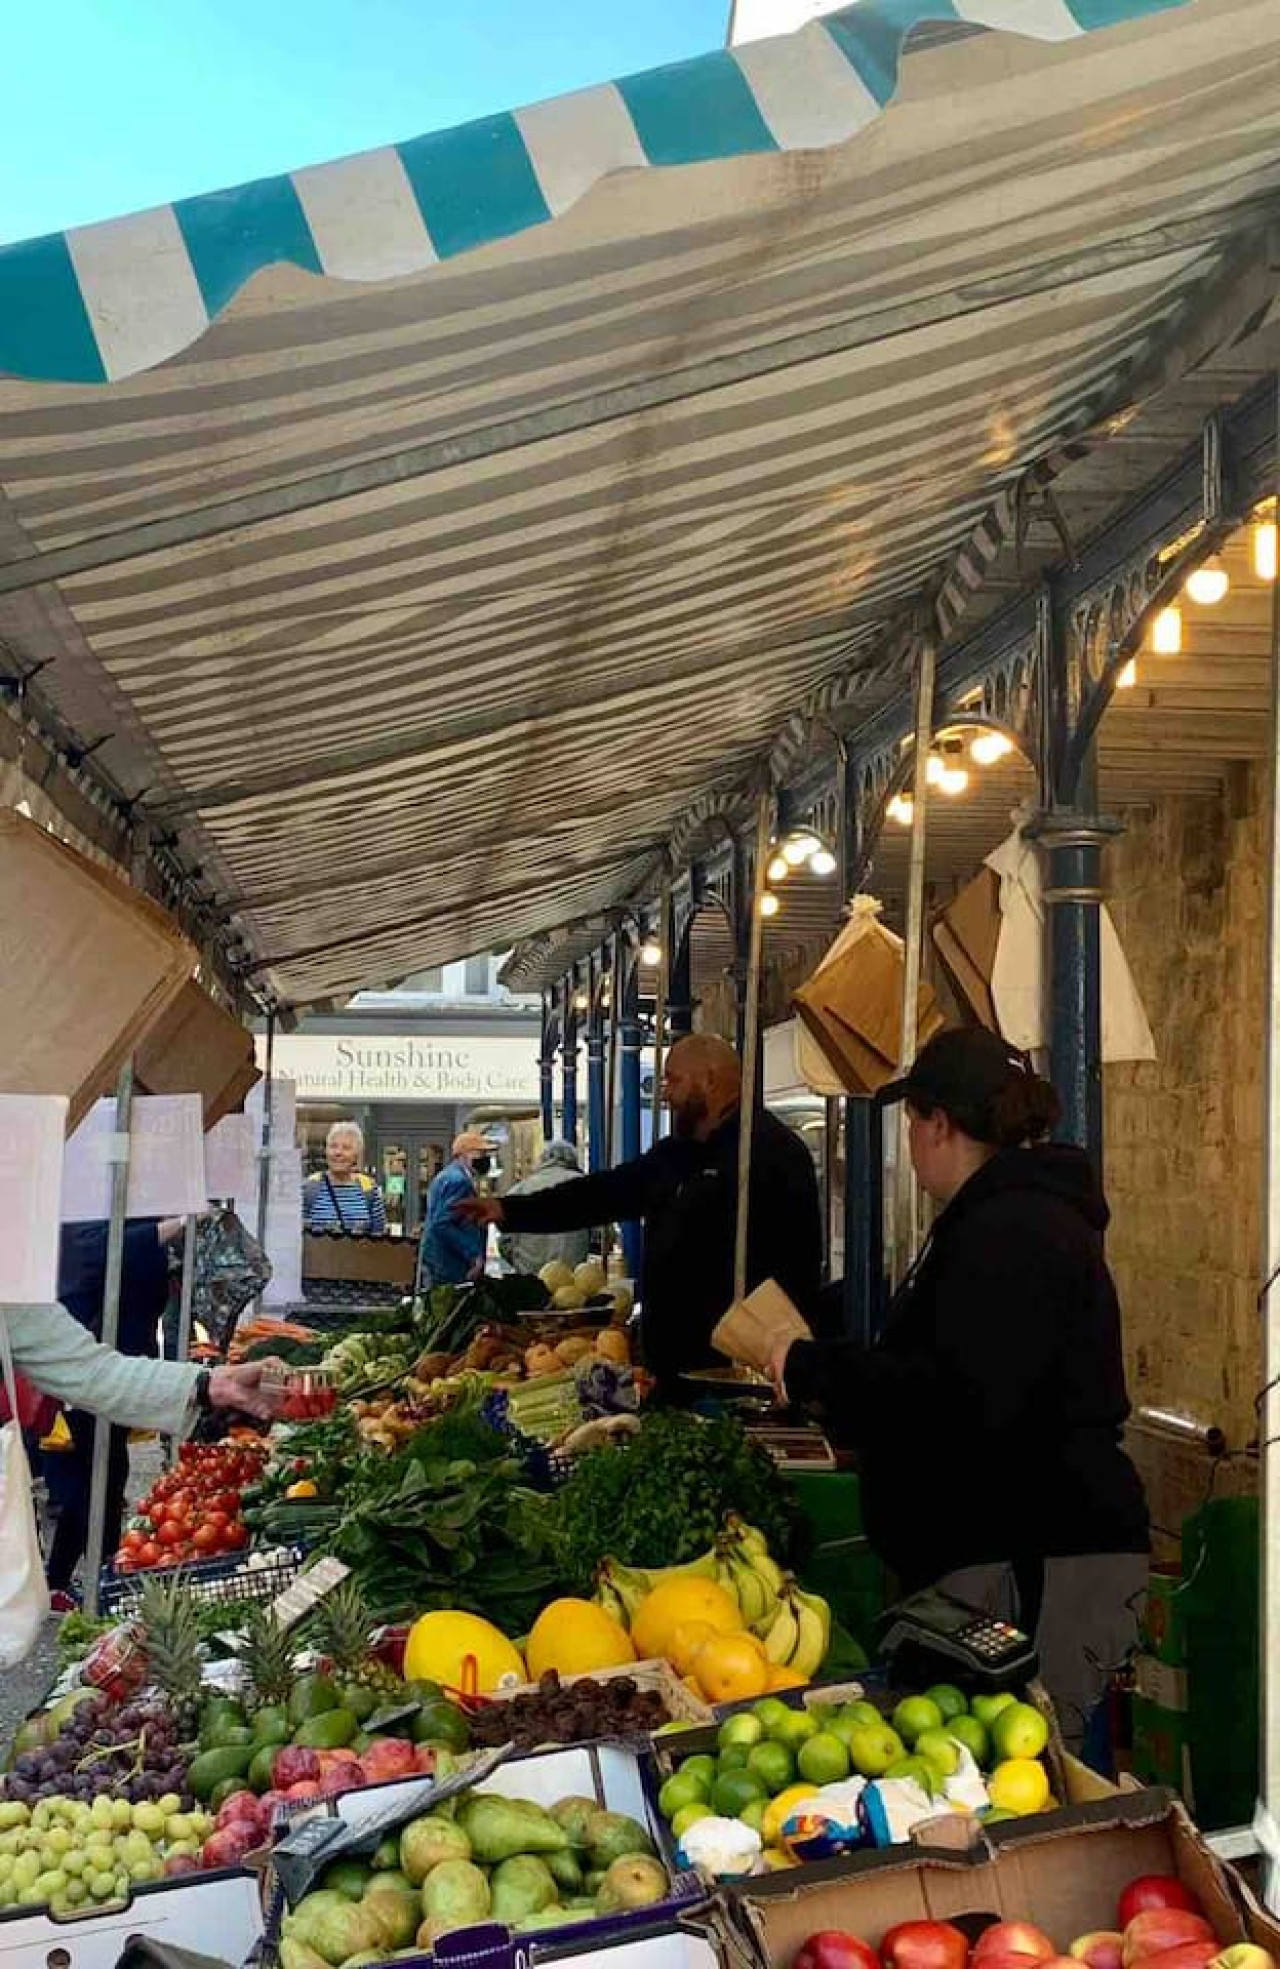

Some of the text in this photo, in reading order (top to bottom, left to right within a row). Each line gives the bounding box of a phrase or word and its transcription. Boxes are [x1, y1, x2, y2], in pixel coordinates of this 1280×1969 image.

[336, 1039, 471, 1069] Sunshine
[350, 1070, 407, 1090] Health
[412, 1074, 428, 1088] &
[437, 1071, 481, 1092] Body
[486, 1073, 527, 1091] Care
